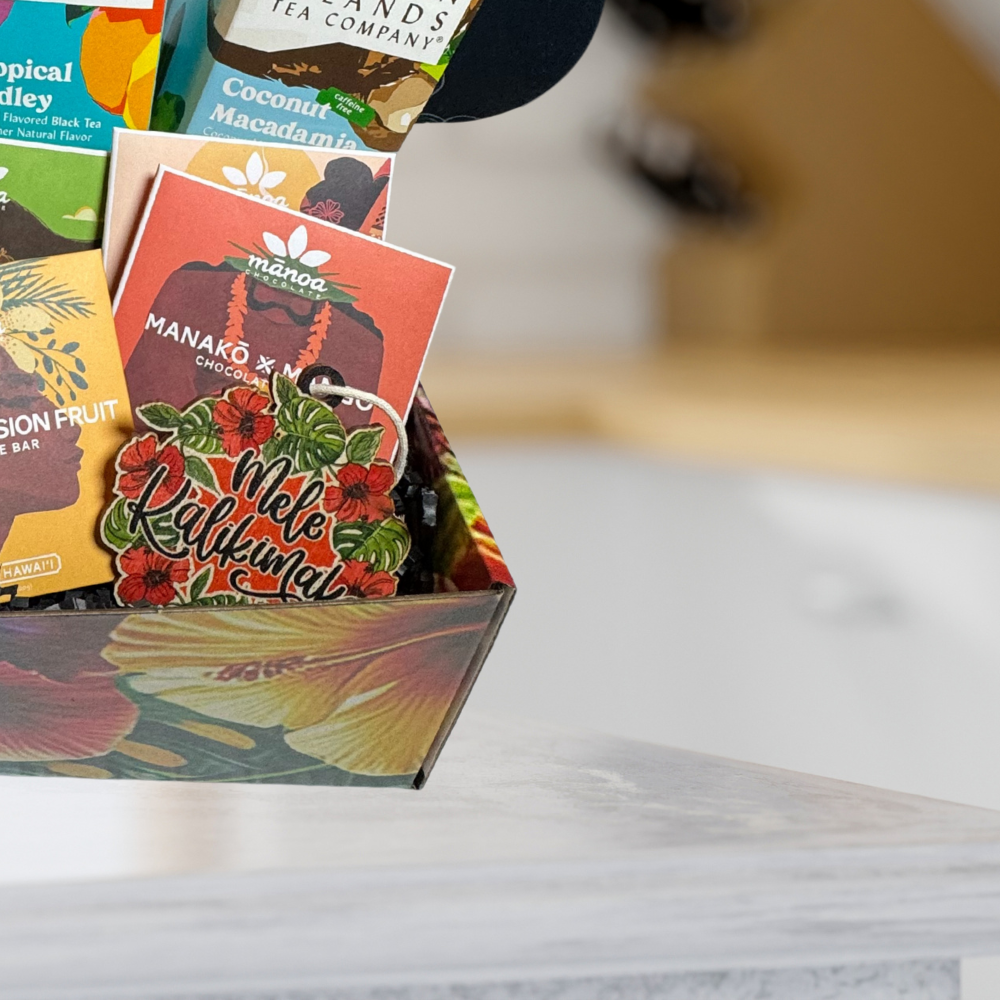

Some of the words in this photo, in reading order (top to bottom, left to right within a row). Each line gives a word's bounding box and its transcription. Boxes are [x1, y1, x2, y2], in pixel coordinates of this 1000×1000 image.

[222, 77, 331, 119] Coconut
[335, 94, 365, 113] caffeine
[336, 103, 352, 115] free
[3, 112, 48, 125] Flavored
[52, 117, 80, 128] Black
[85, 120, 101, 129] Tea
[17, 129, 56, 139] Natural
[60, 131, 92, 142] Flavor
[209, 103, 357, 150] Macadamia
[245, 269, 321, 299] CHOCOLATE
[248, 255, 328, 292] mānoa
[195, 356, 268, 389] CHOCOLAT
[56, 399, 119, 431] FRUIT
[12, 439, 40, 453] BAR
[231, 451, 325, 543] Mele
